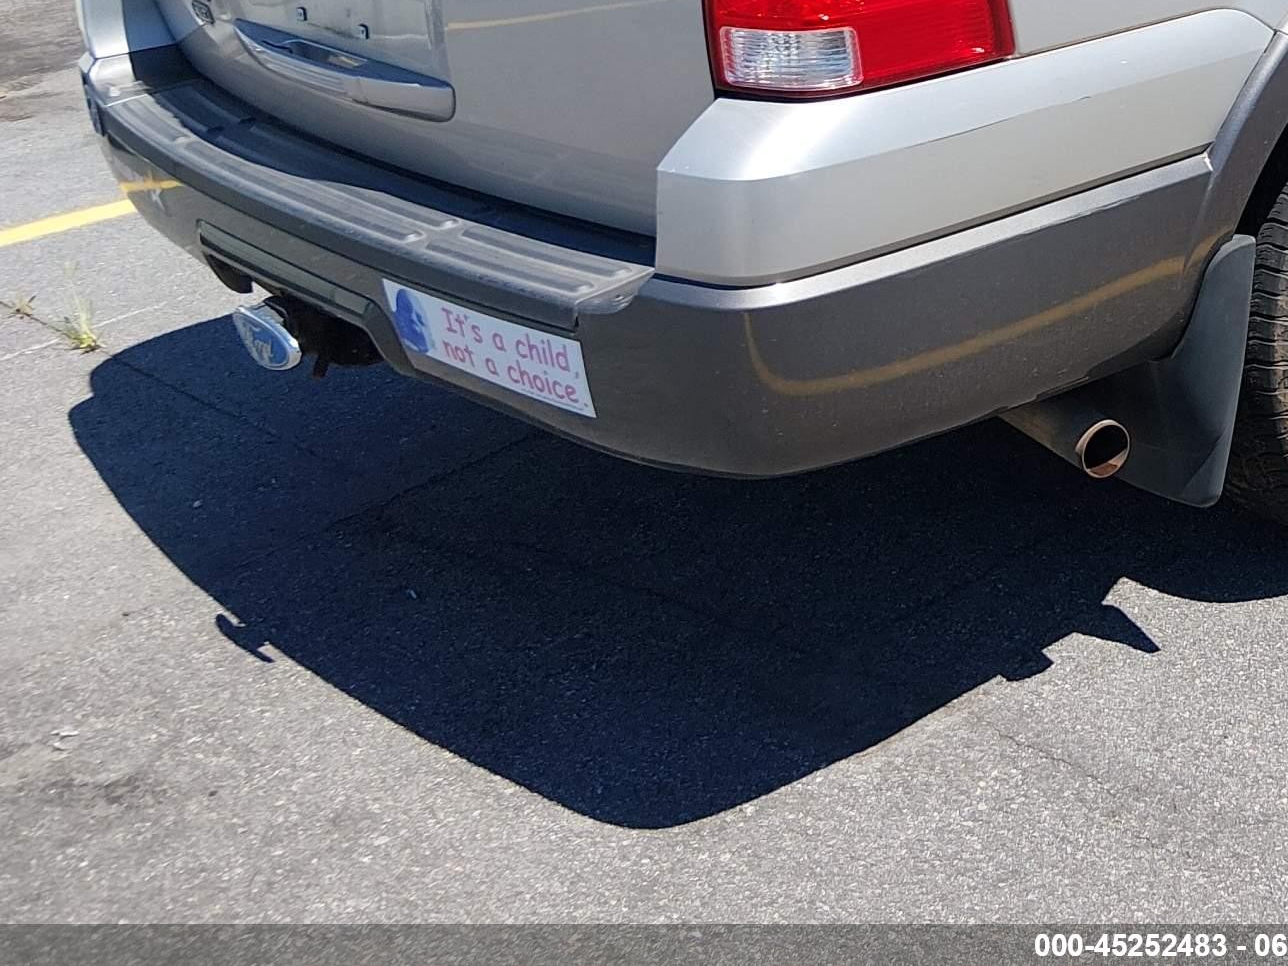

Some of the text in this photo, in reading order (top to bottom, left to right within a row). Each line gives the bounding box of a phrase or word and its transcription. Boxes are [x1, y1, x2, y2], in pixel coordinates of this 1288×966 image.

[441, 306, 580, 380] It's a child,
[441, 339, 476, 369] not
[484, 356, 500, 377] a
[506, 359, 589, 408] choice.
